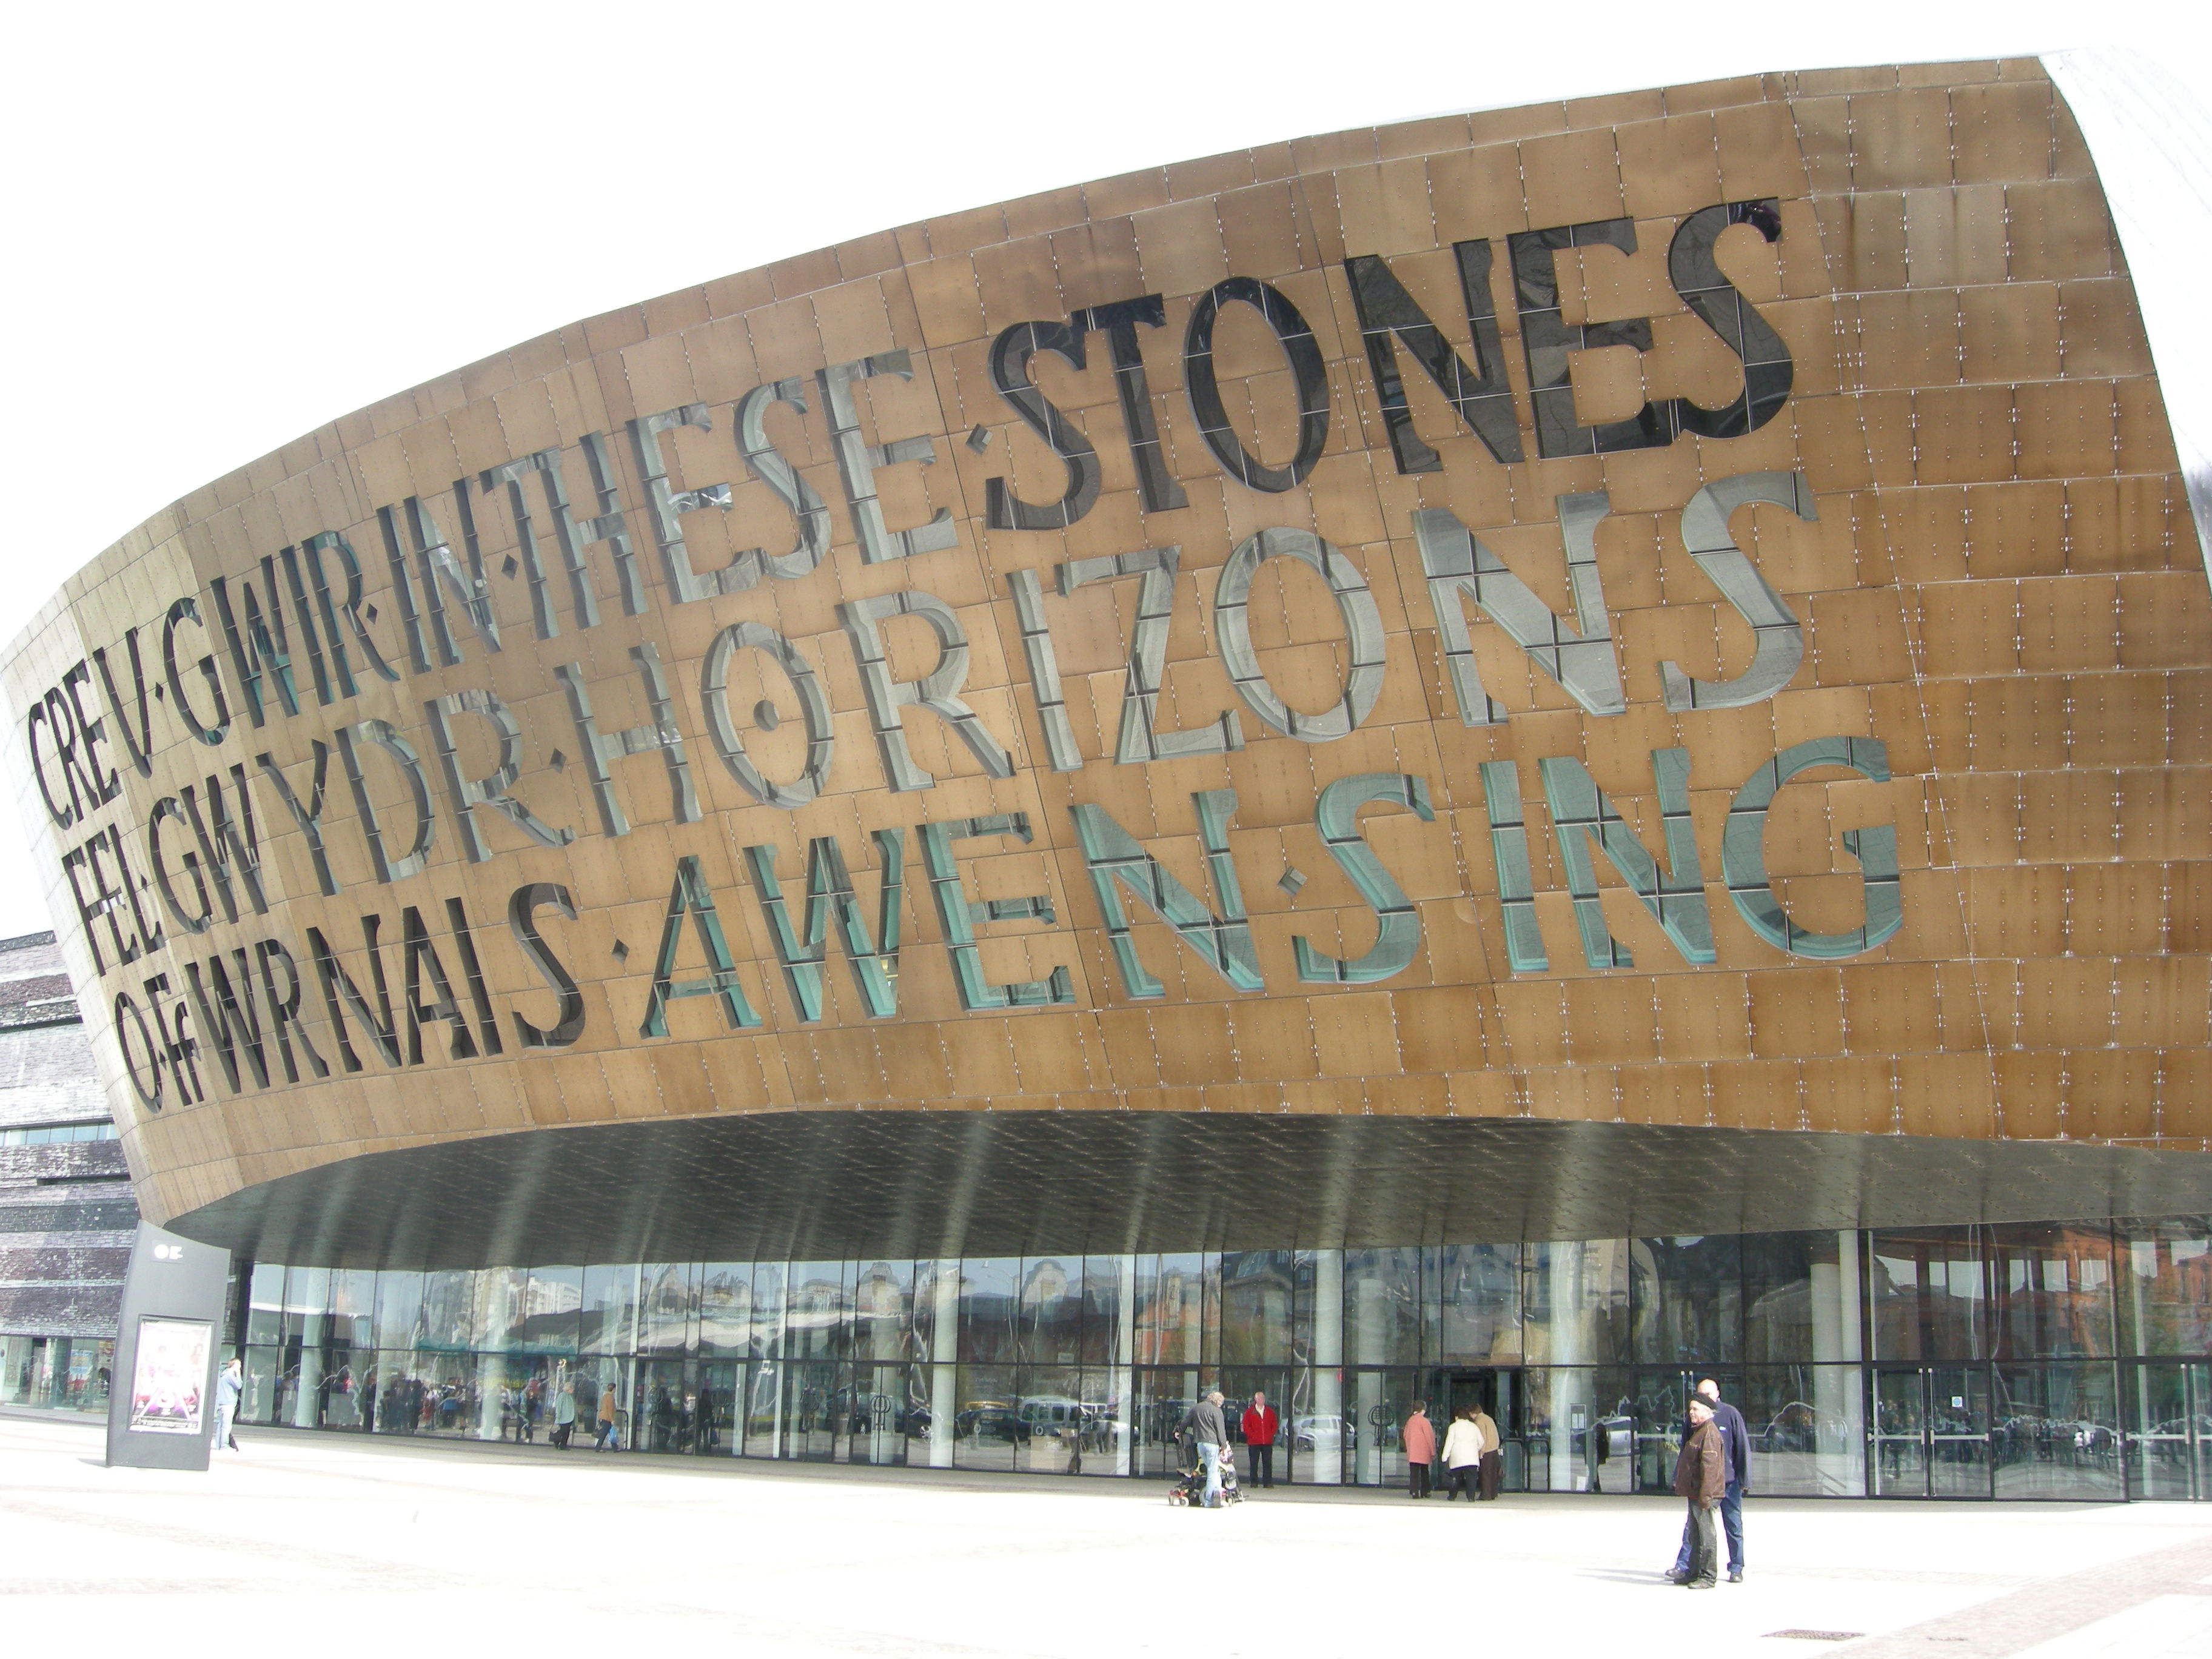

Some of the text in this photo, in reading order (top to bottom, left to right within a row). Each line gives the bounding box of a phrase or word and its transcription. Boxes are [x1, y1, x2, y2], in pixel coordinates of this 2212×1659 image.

[62, 471, 1819, 977] FEL GWYDR HORIZONS
[163, 530, 400, 746] GWIR
[376, 475, 501, 675] IN
[478, 348, 958, 640] THESE
[985, 197, 1794, 531] STONES
[639, 788, 1264, 1039] AWEN
[1292, 735, 1903, 984] SING
